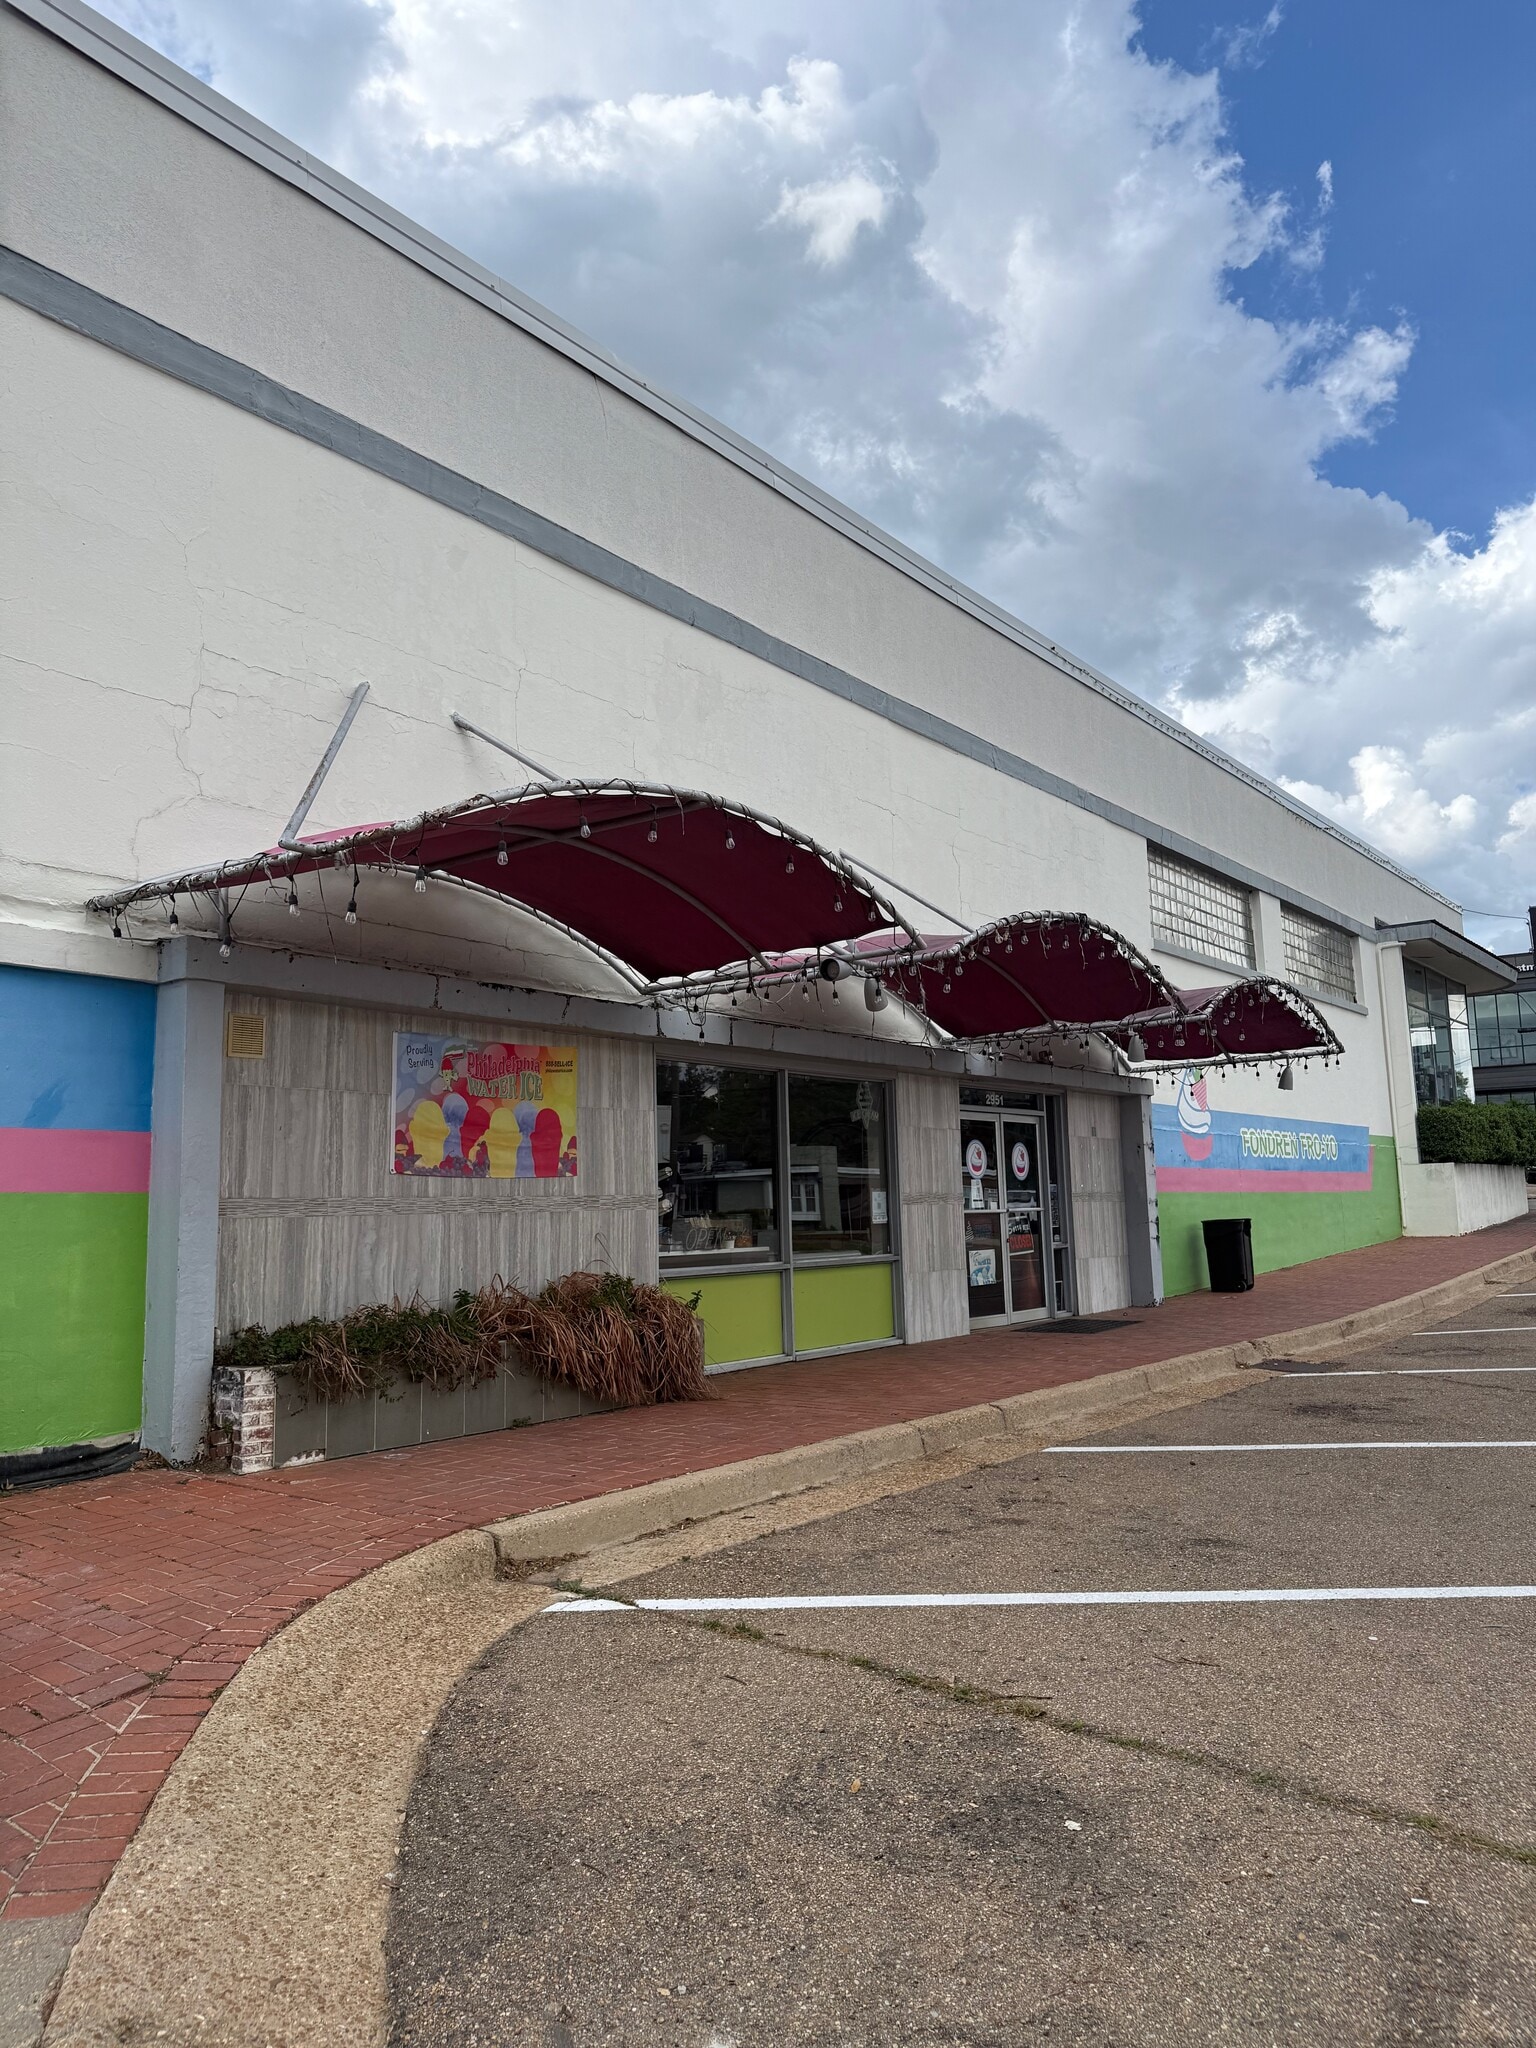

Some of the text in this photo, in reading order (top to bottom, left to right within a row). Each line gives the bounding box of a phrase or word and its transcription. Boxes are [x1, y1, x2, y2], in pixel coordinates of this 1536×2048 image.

[406, 1044, 433, 1056] Proudly
[408, 1058, 434, 1068] Serving
[467, 1051, 541, 1079] Philadelphia
[467, 1071, 543, 1101] WATER ICE
[985, 1094, 1004, 1106] 2951
[1240, 1128, 1338, 1160] FONDREN FRO-YO
[686, 1227, 727, 1251] OPEN
